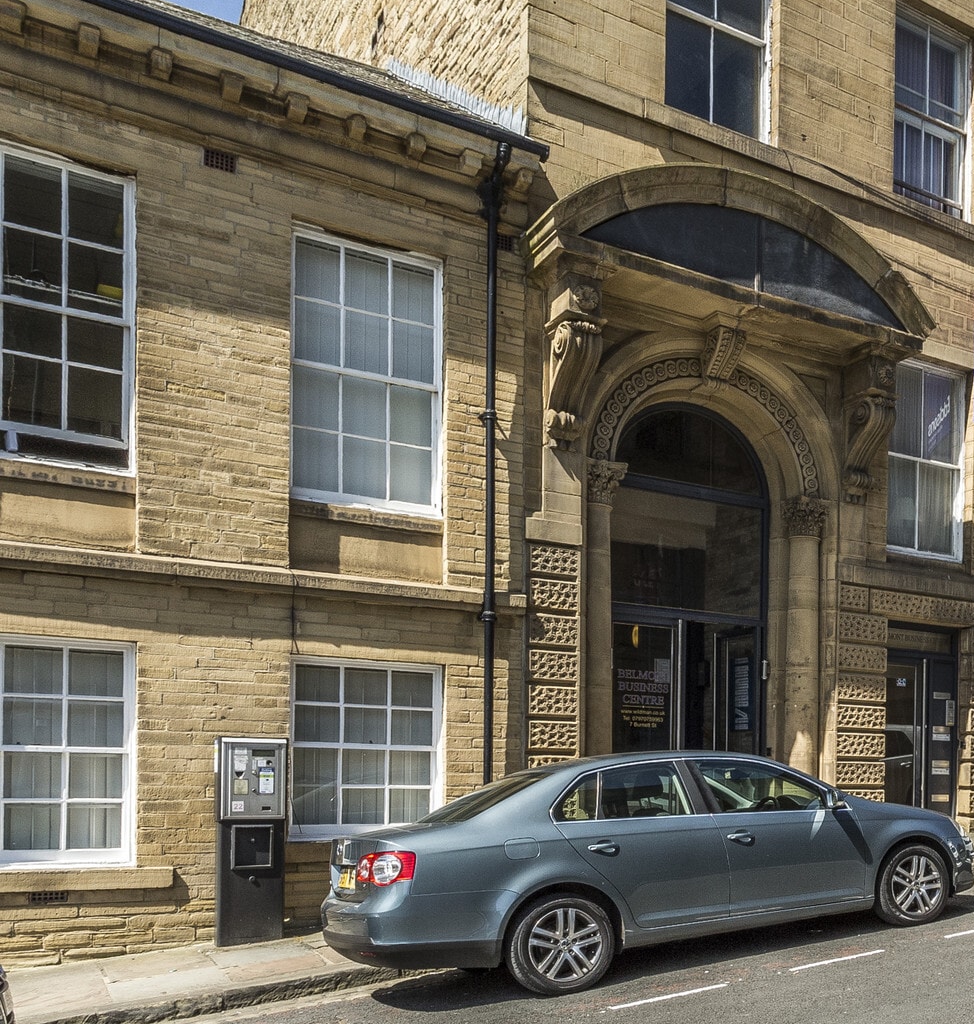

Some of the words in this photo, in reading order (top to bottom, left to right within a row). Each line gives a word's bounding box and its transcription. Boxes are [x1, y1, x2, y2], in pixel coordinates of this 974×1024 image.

[617, 668, 668, 682] BELMO
[617, 681, 669, 693] BUSINESS
[622, 693, 665, 705] CENTRE
